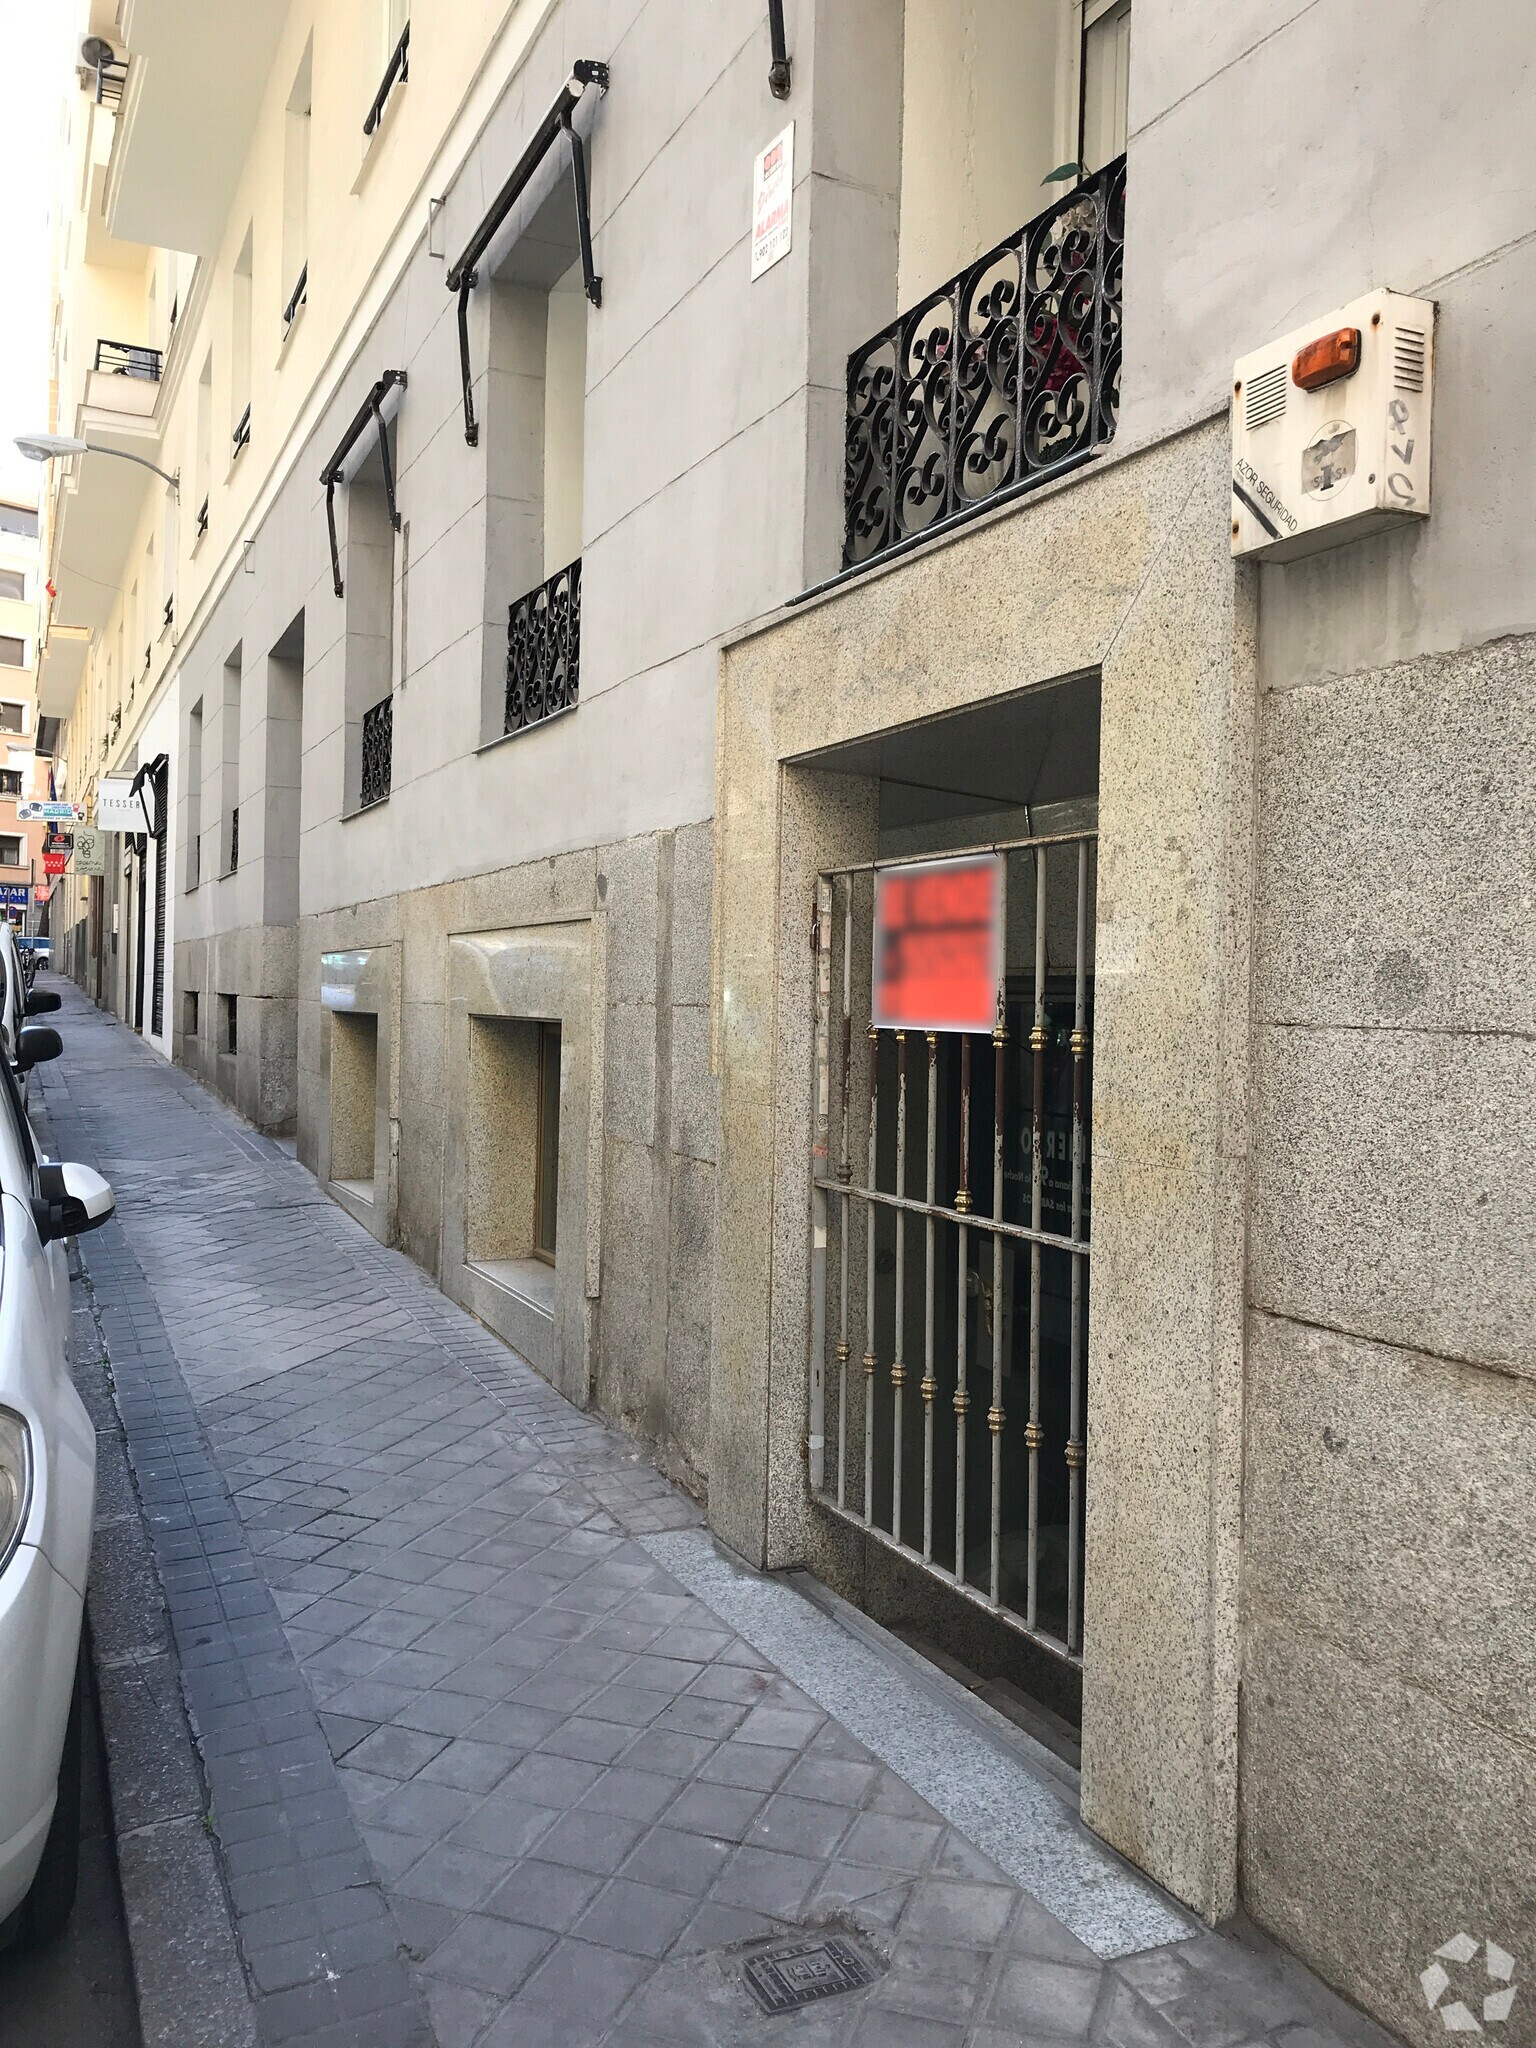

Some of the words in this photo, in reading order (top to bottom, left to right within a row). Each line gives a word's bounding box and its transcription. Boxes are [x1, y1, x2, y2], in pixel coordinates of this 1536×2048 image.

[755, 198, 789, 240] ALARMA
[1235, 458, 1259, 486] AZOR
[1256, 481, 1298, 531] SEGURIDAD
